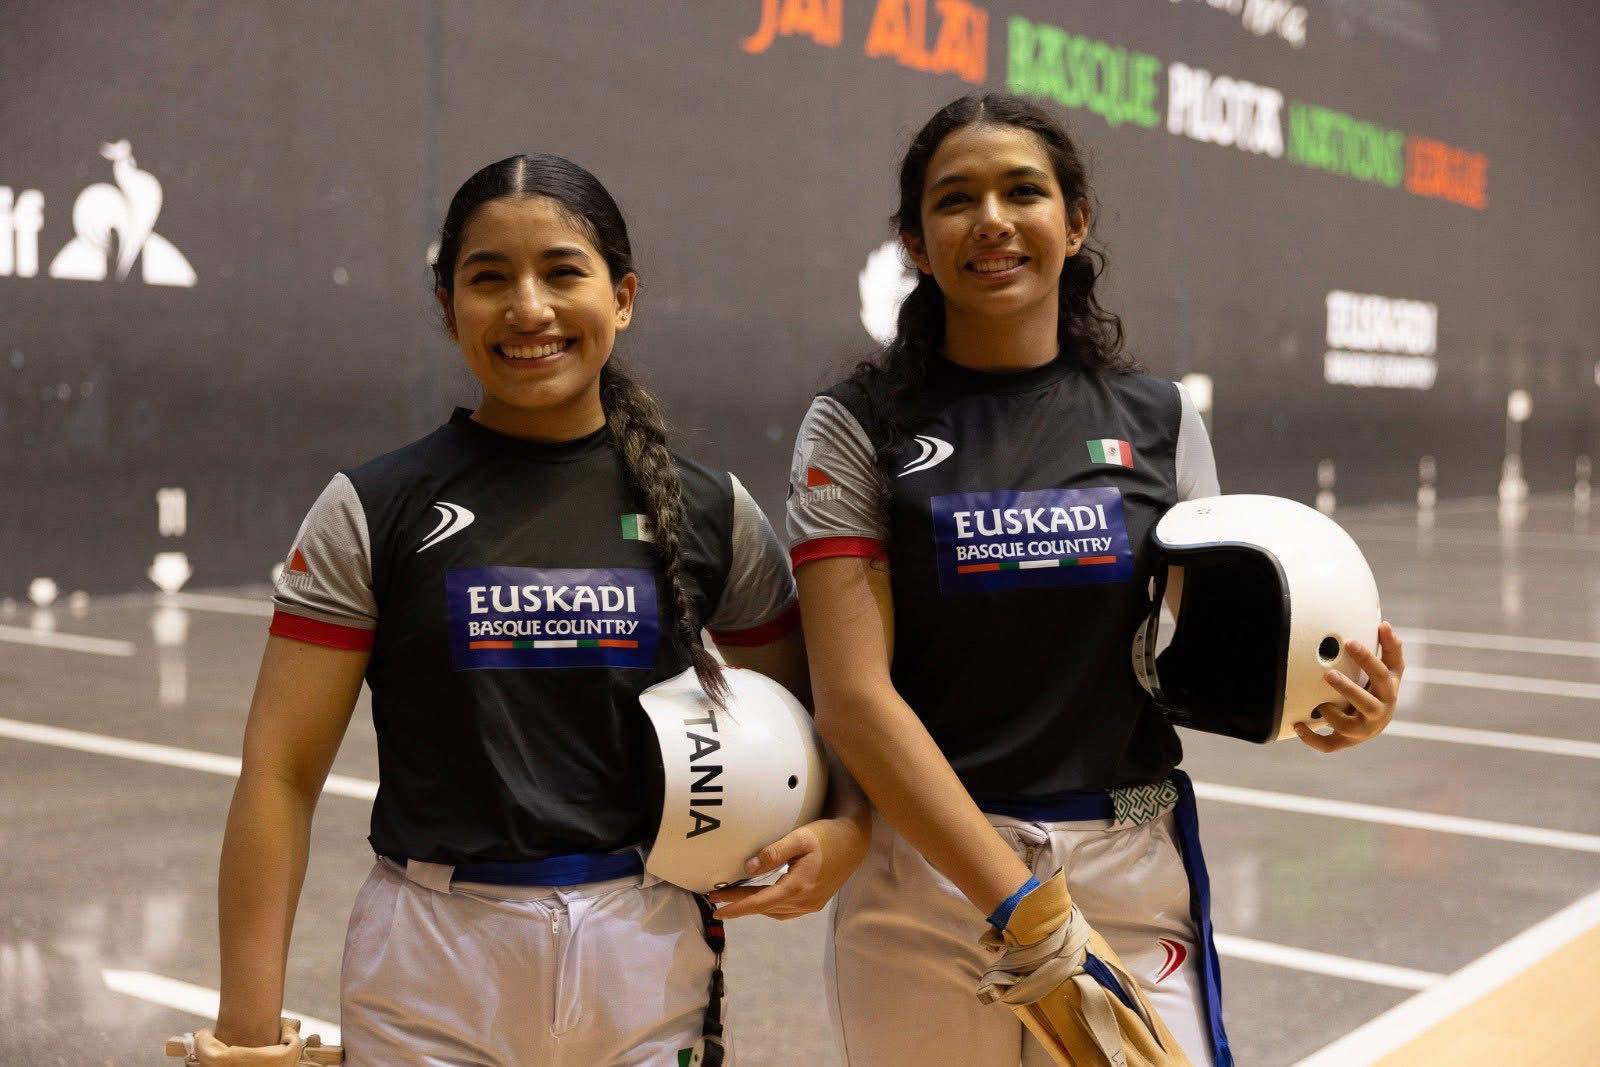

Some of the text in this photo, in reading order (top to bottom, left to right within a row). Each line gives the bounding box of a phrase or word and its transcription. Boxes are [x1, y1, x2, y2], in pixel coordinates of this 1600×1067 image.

[864, 0, 989, 85] ALAI
[1007, 19, 1159, 127] BASQUE
[1167, 63, 1284, 158] PILOTA
[953, 505, 1108, 538] EUSKADI
[956, 537, 1112, 561] BASQUE COUNTRY
[467, 585, 636, 614] EUSKADI
[468, 619, 639, 637] BASQUE COUNTRY
[684, 709, 723, 839] TANIA
